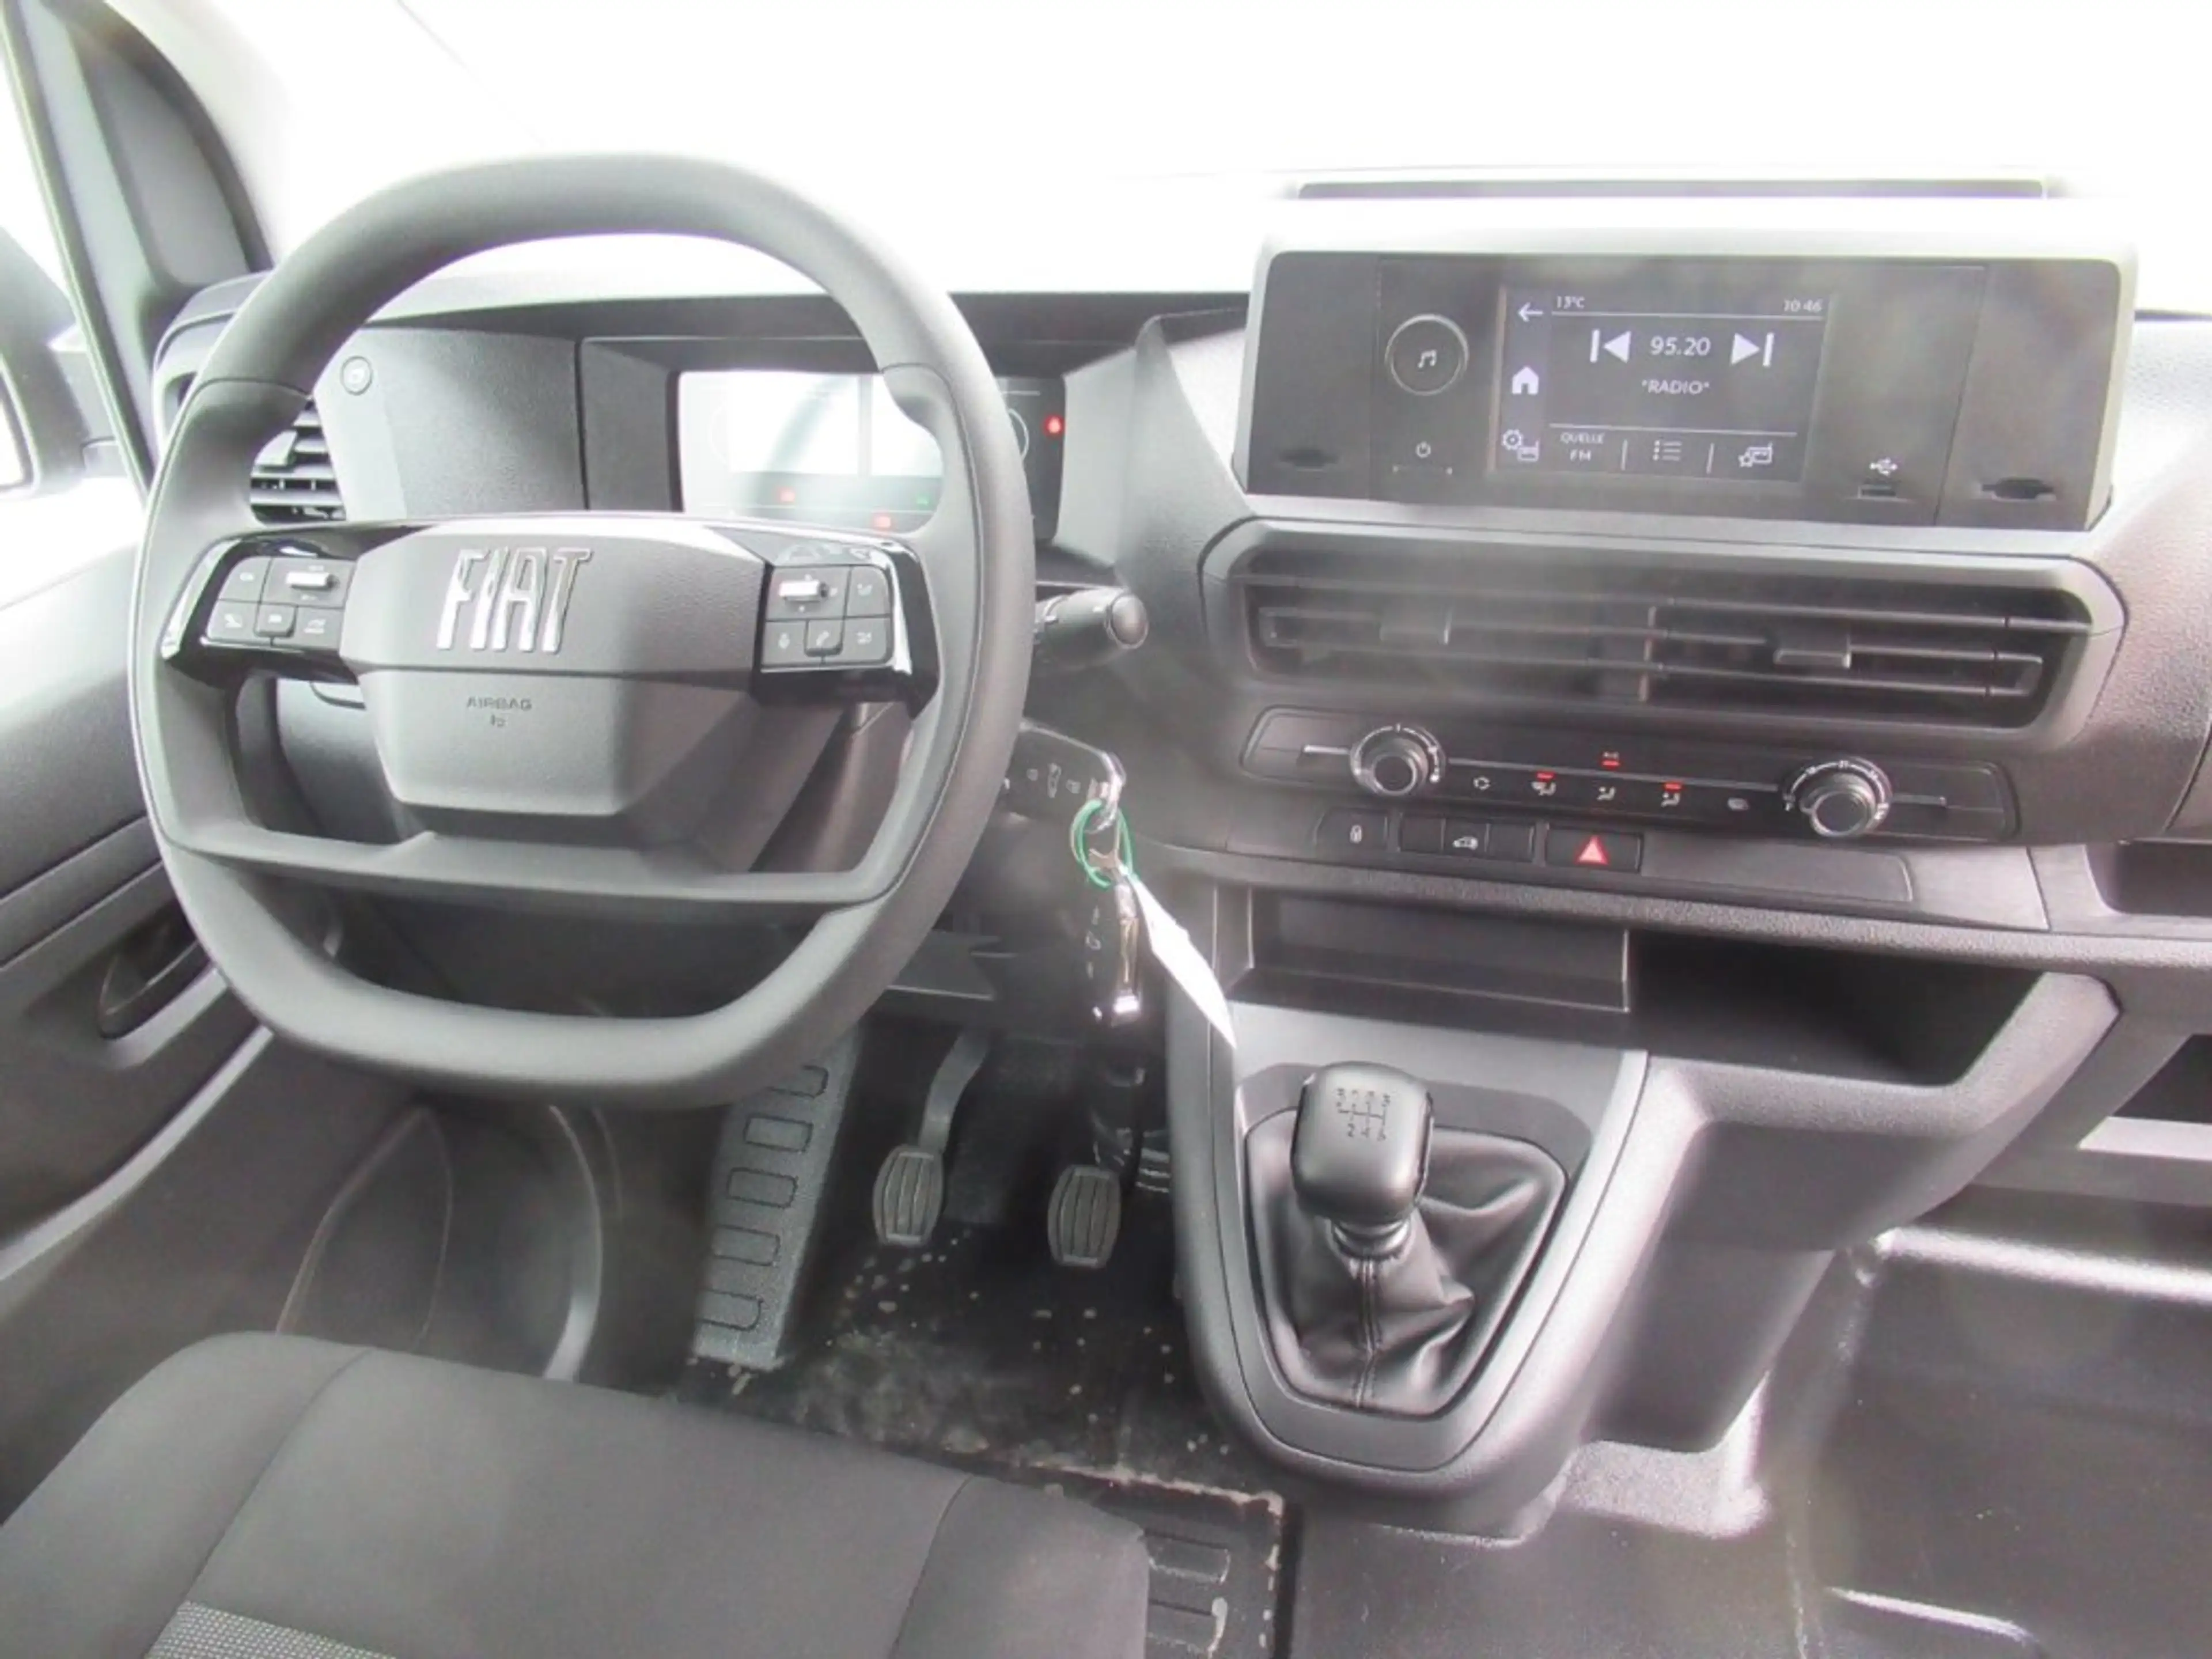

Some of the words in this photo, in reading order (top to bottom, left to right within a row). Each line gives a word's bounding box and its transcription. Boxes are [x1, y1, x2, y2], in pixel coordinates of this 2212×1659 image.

[1650, 335, 1711, 356] 95.20
[1570, 449, 1592, 461] FM
[436, 546, 593, 654] FIAT
[466, 696, 532, 711] AIRBAG
